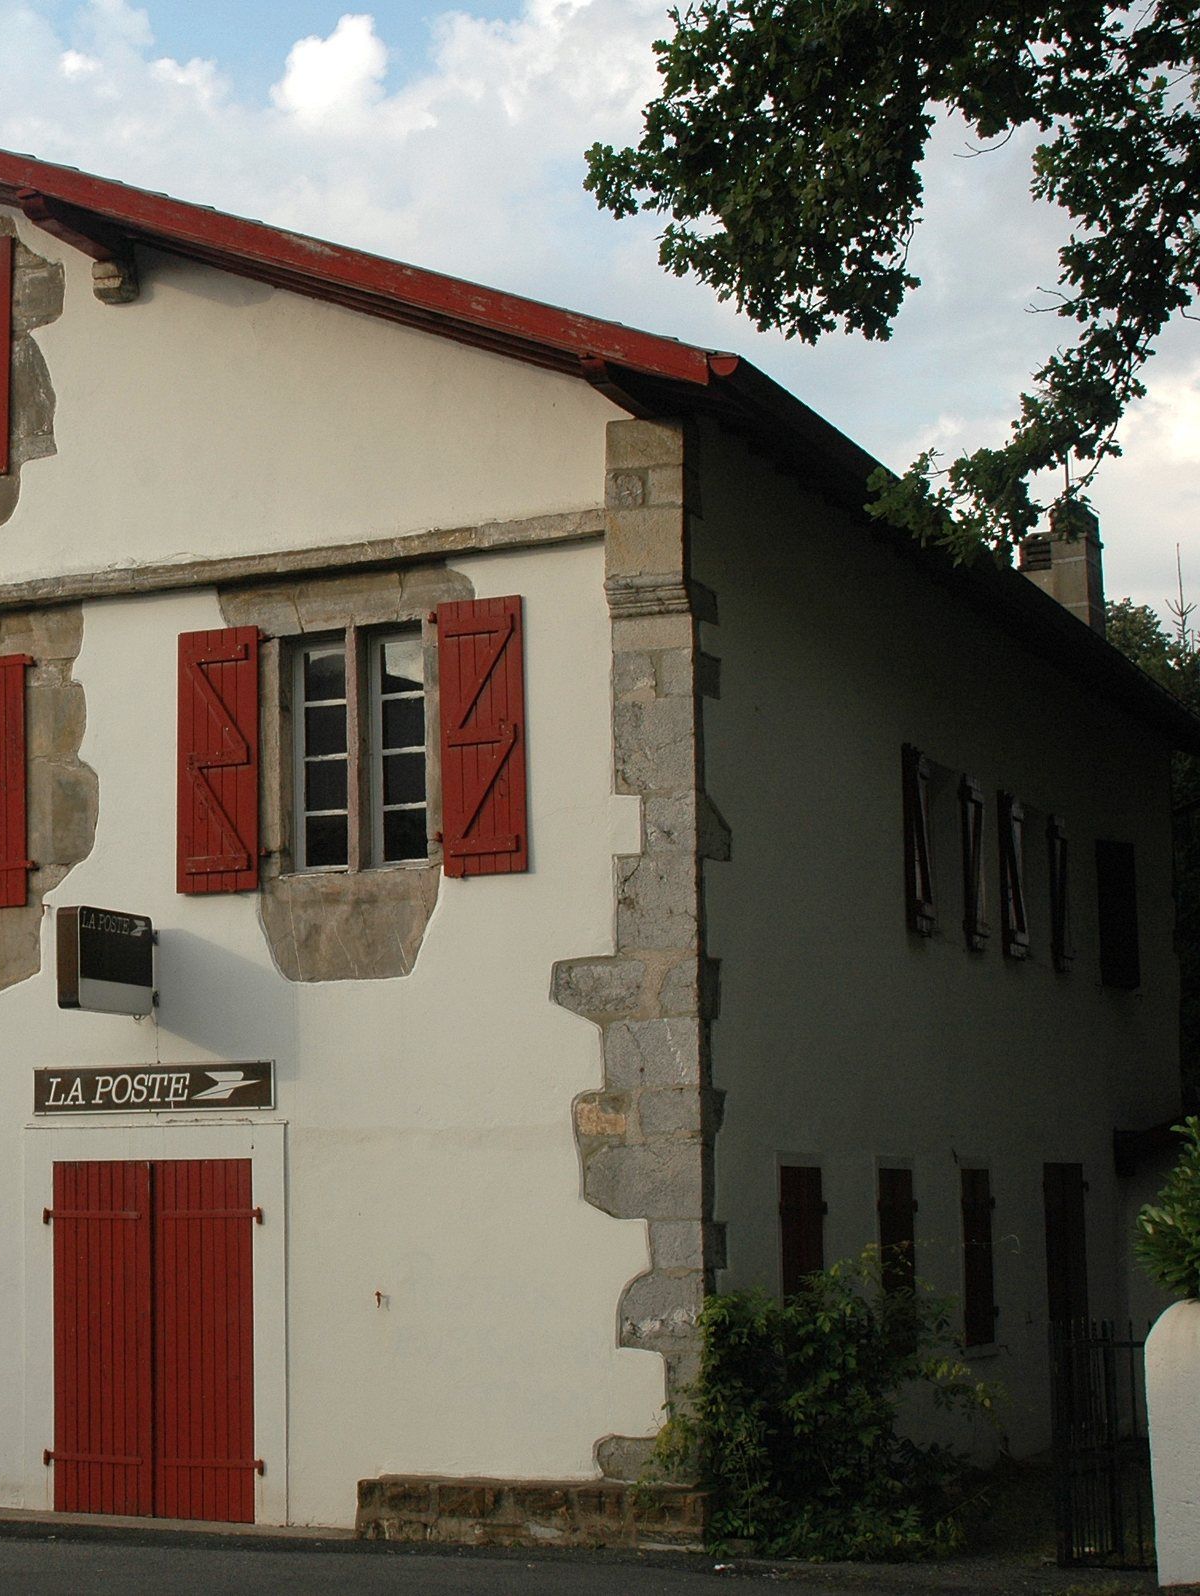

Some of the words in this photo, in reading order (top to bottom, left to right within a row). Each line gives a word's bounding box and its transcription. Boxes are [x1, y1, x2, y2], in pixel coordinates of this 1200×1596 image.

[81, 910, 96, 929] LA
[98, 913, 129, 935] POSTE
[45, 1077, 86, 1105] LA
[91, 1073, 190, 1104] POSTE
